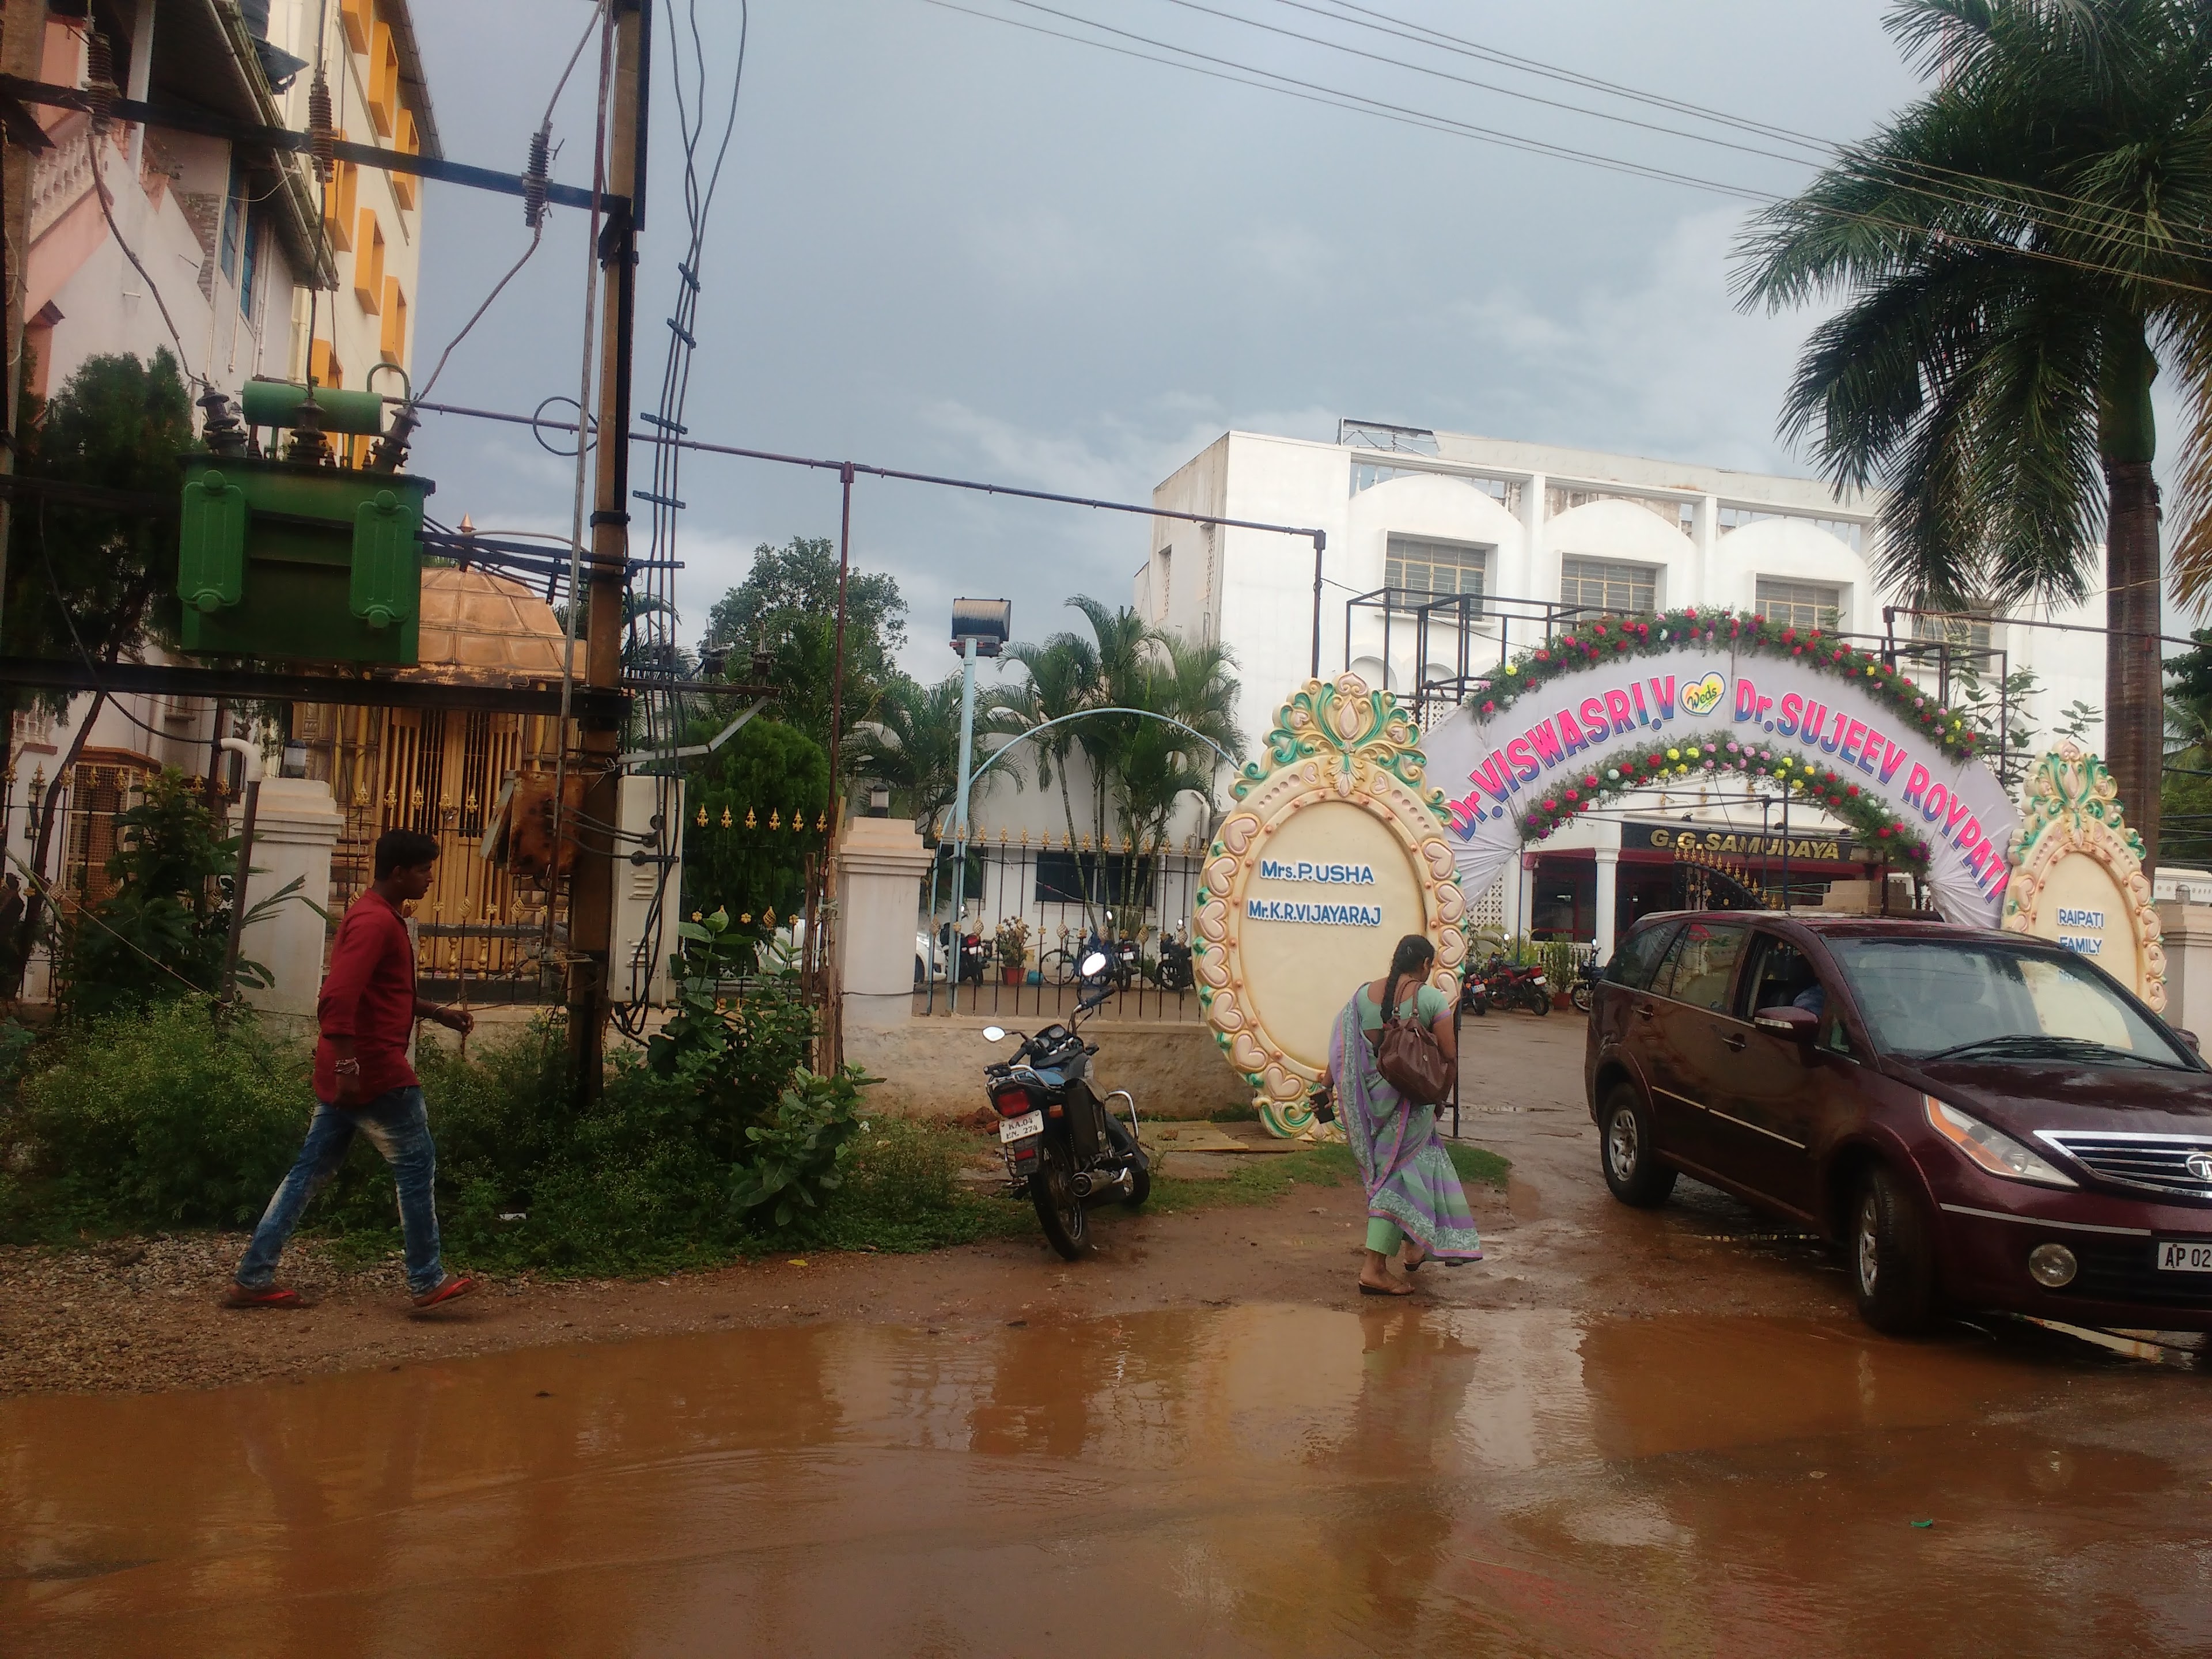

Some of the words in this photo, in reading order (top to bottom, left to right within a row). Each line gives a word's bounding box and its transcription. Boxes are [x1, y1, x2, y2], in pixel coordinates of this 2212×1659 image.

[1686, 684, 1718, 710] Weds
[1901, 761, 2010, 904] ROYPATI
[2059, 908, 2104, 927] RAIPATI
[2059, 937, 2103, 953] FAMILY
[2165, 1247, 2186, 1267] AP
[2191, 1248, 2211, 1267] 02
